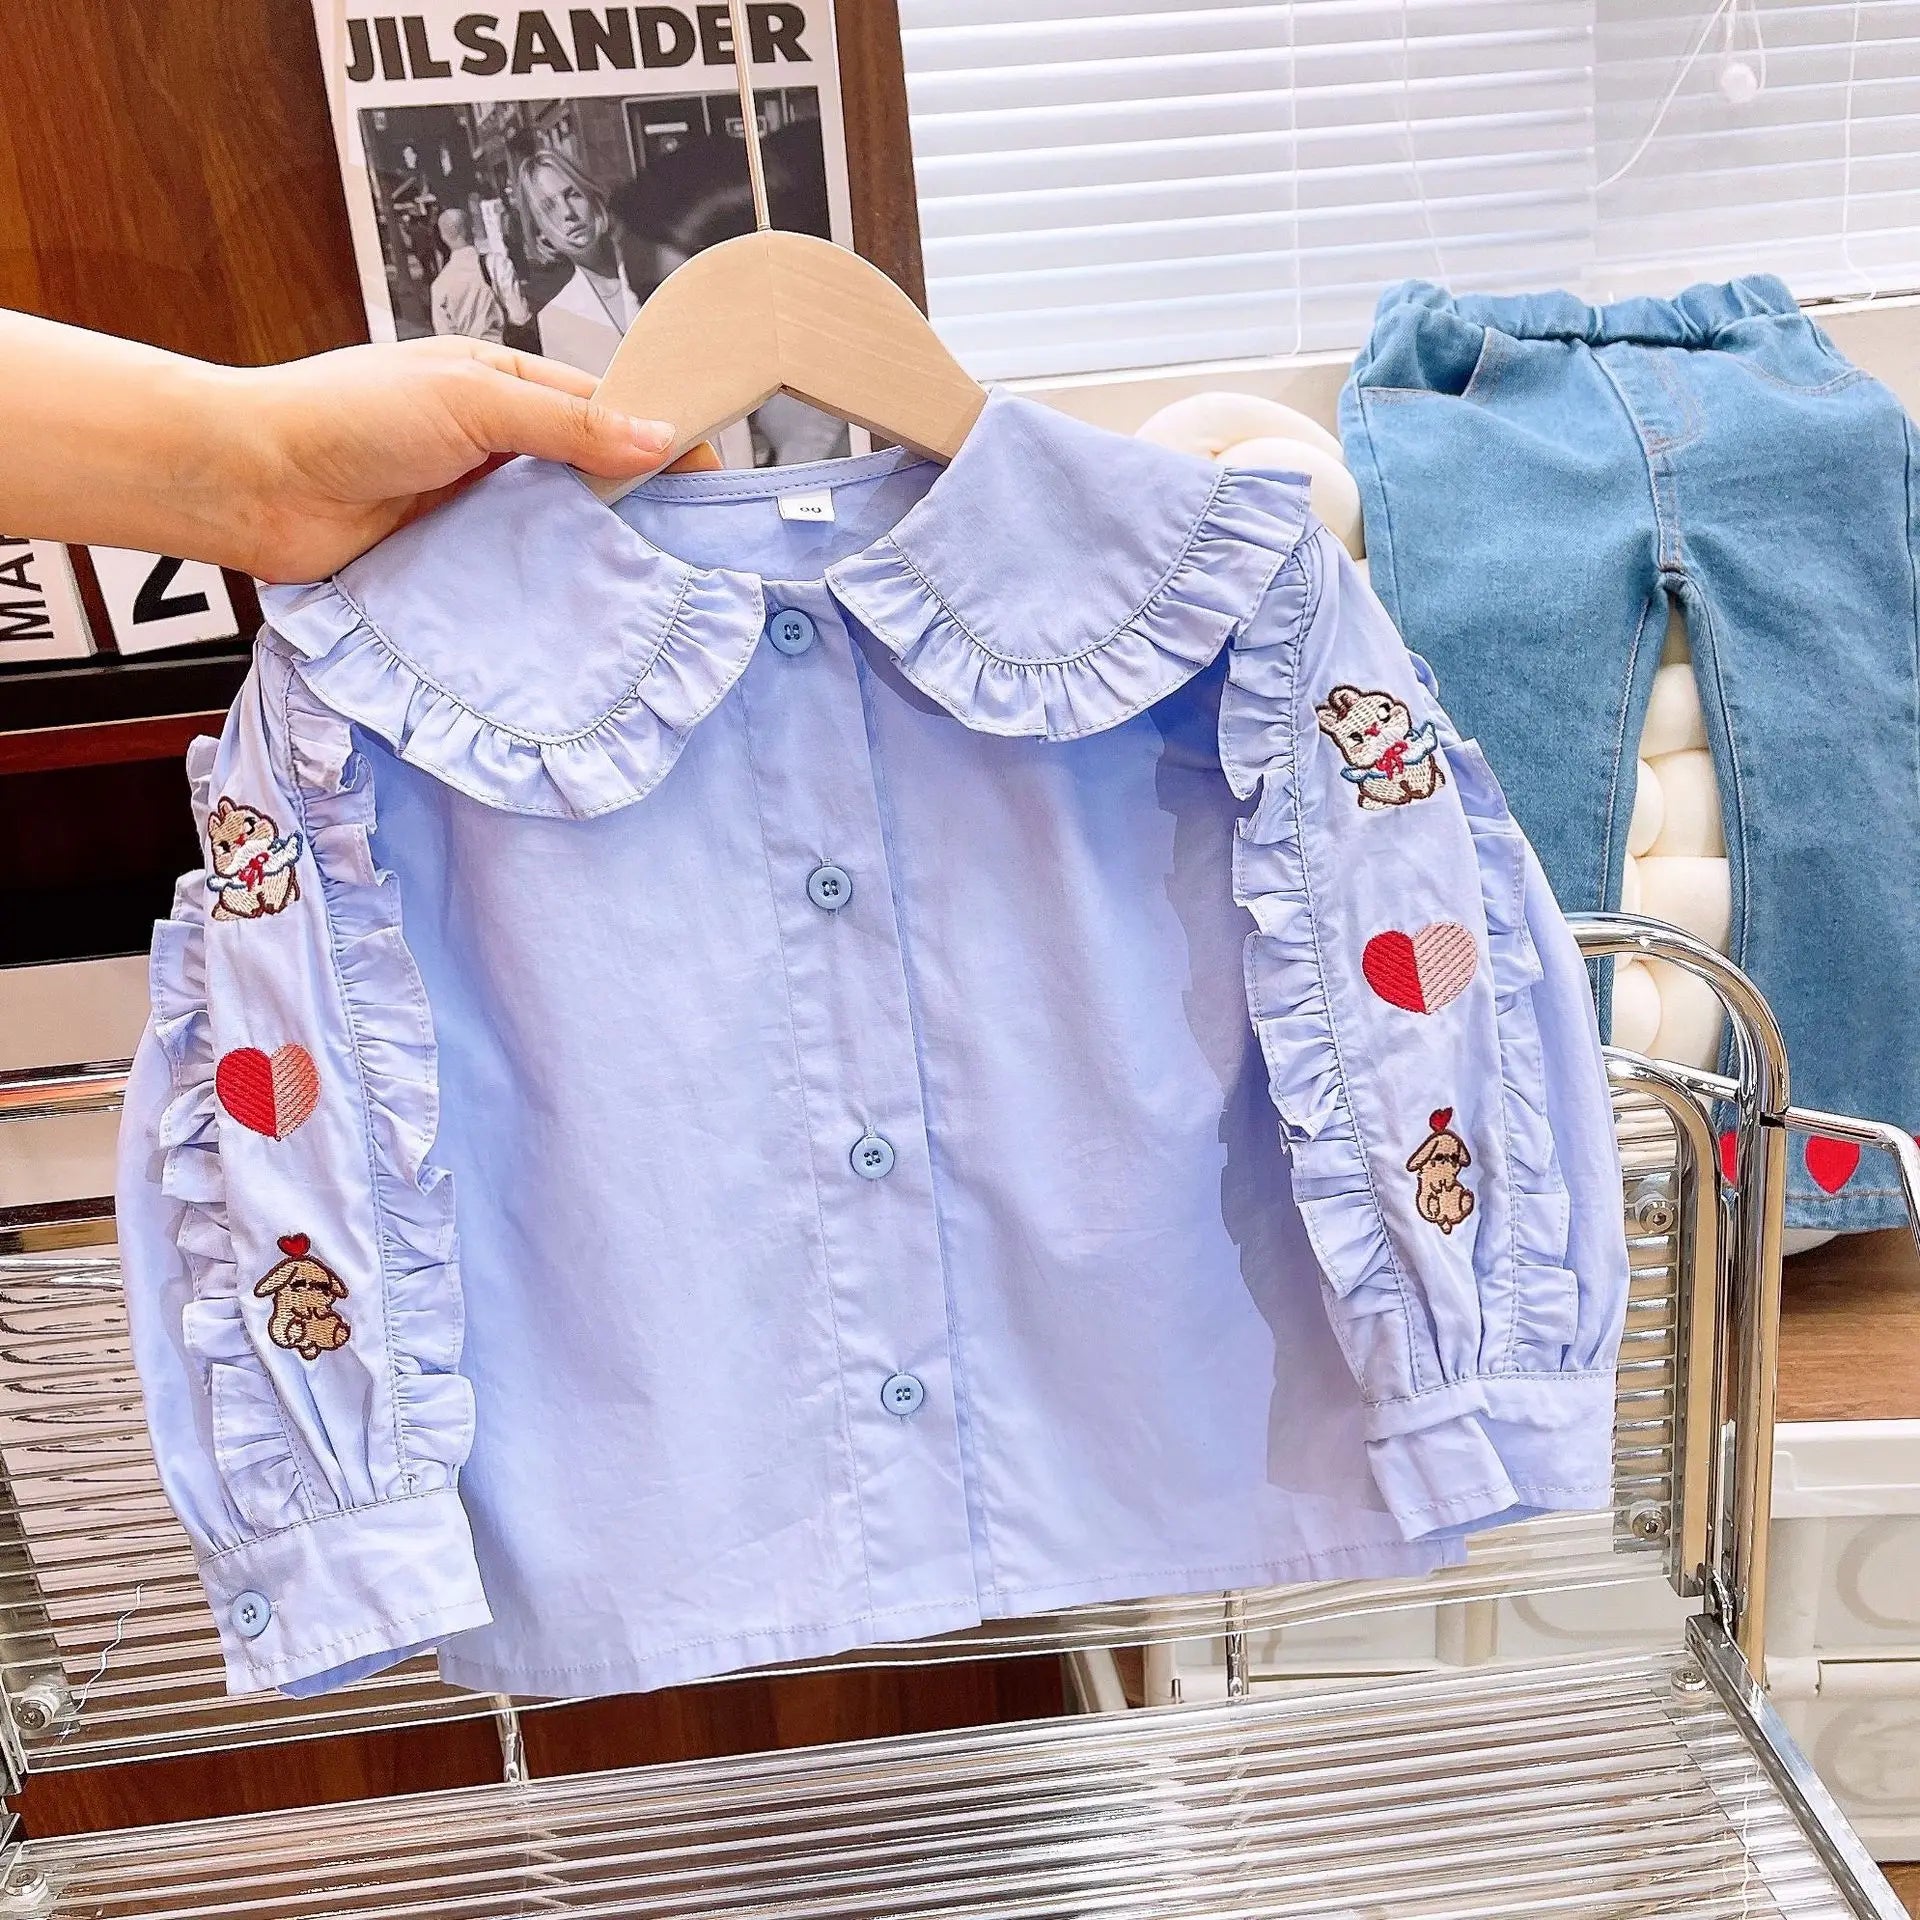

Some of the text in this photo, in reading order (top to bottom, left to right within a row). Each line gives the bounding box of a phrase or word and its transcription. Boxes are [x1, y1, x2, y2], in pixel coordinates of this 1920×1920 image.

[346, 2, 812, 82] JIL SANDER
[0, 535, 54, 641] MA
